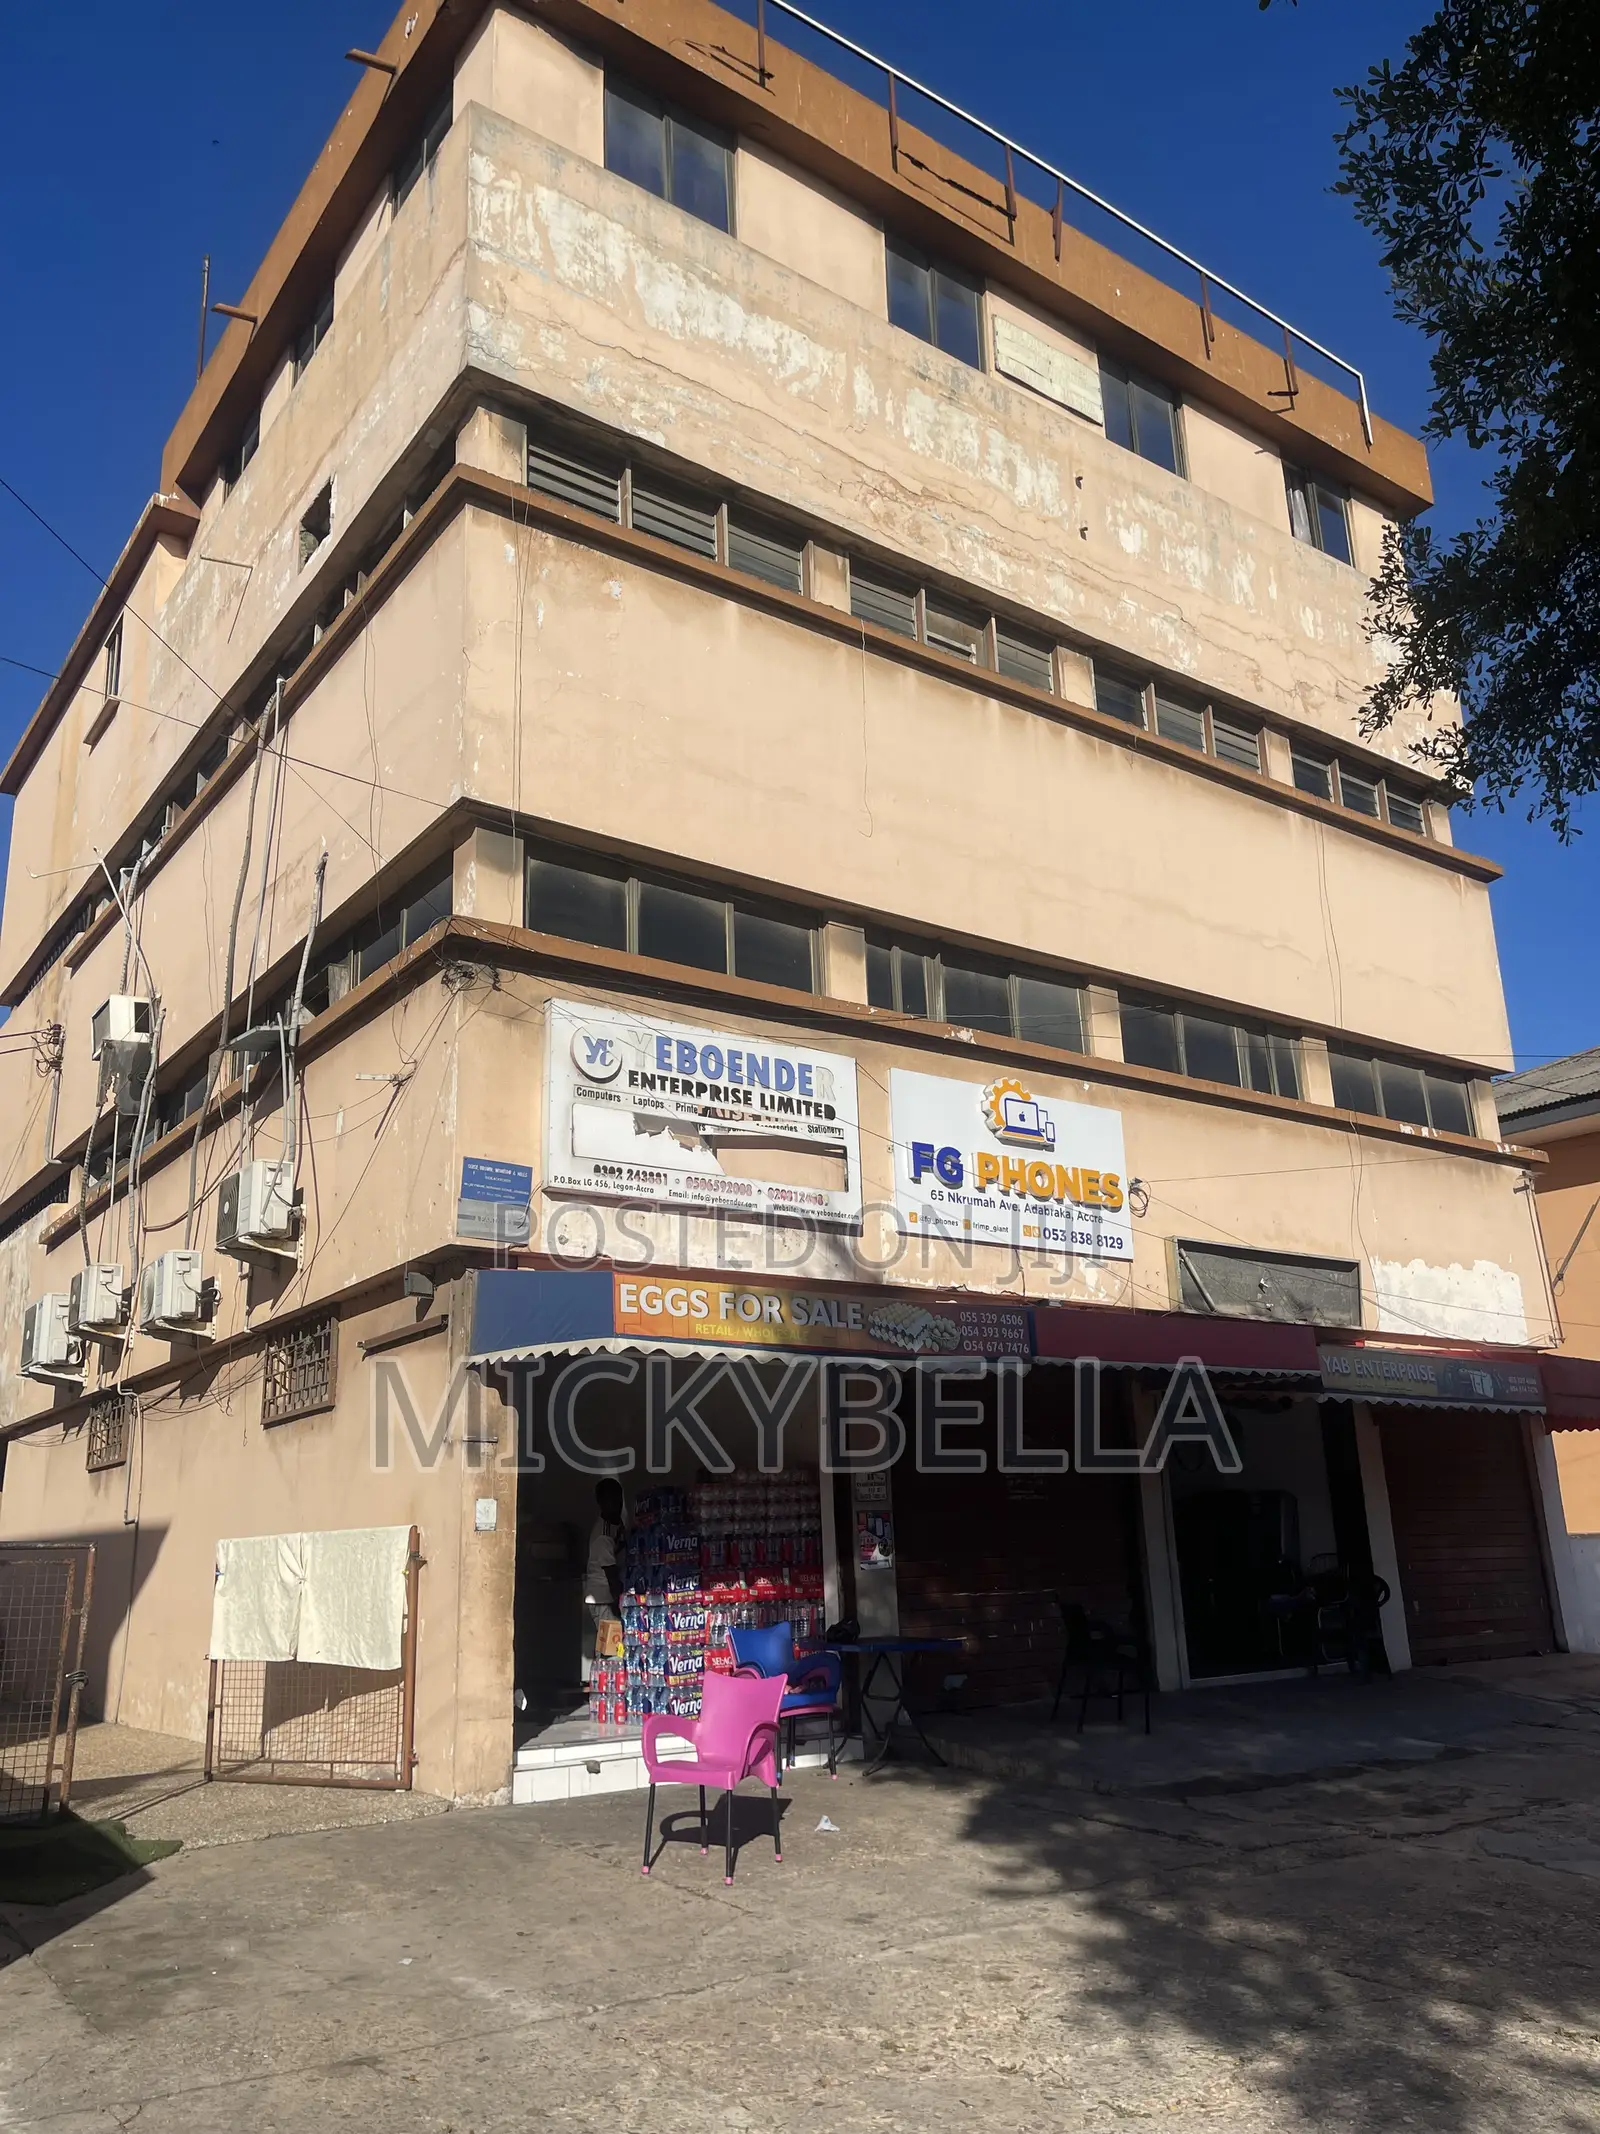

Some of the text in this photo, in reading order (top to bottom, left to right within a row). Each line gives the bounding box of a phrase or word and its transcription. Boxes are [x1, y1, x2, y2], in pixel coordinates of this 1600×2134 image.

[626, 1029, 836, 1102] YEBOENDER
[576, 1086, 621, 1104] Computers
[632, 1095, 665, 1111] Laptops
[628, 1069, 753, 1108] ENTERPRISE
[759, 1092, 837, 1121] LIMITED
[807, 1124, 842, 1136] Stationery
[907, 1141, 1124, 1212] FG PHONES
[583, 1178, 592, 1187] LG
[594, 1179, 611, 1190] 456,
[613, 1182, 655, 1195] Legon-Accra
[668, 1189, 690, 1200] Email:
[691, 1191, 758, 1209] info@yeboender.com
[773, 1203, 799, 1214] Website:
[930, 1189, 1104, 1225] 65 Nkrumah Ave. Adabraka, Accra
[1042, 1227, 1124, 1250] 053 838 8129
[619, 1283, 866, 1330] EGGS FOR SALE
[959, 1311, 1024, 1326] 055 329 4506
[695, 1323, 735, 1337] RETAIL
[743, 1326, 809, 1341] WHOLESALE
[961, 1325, 1024, 1340] 054 393 9667
[986, 1341, 1004, 1353] 674
[1005, 1342, 1029, 1354] 7476
[1321, 1354, 1437, 1383] YAB ENTERPRISE
[666, 1534, 698, 1551] Verna
[668, 1573, 700, 1591] Verna
[672, 1612, 704, 1629] Verna
[670, 1655, 703, 1674] Verna
[671, 1698, 702, 1717] Verna
